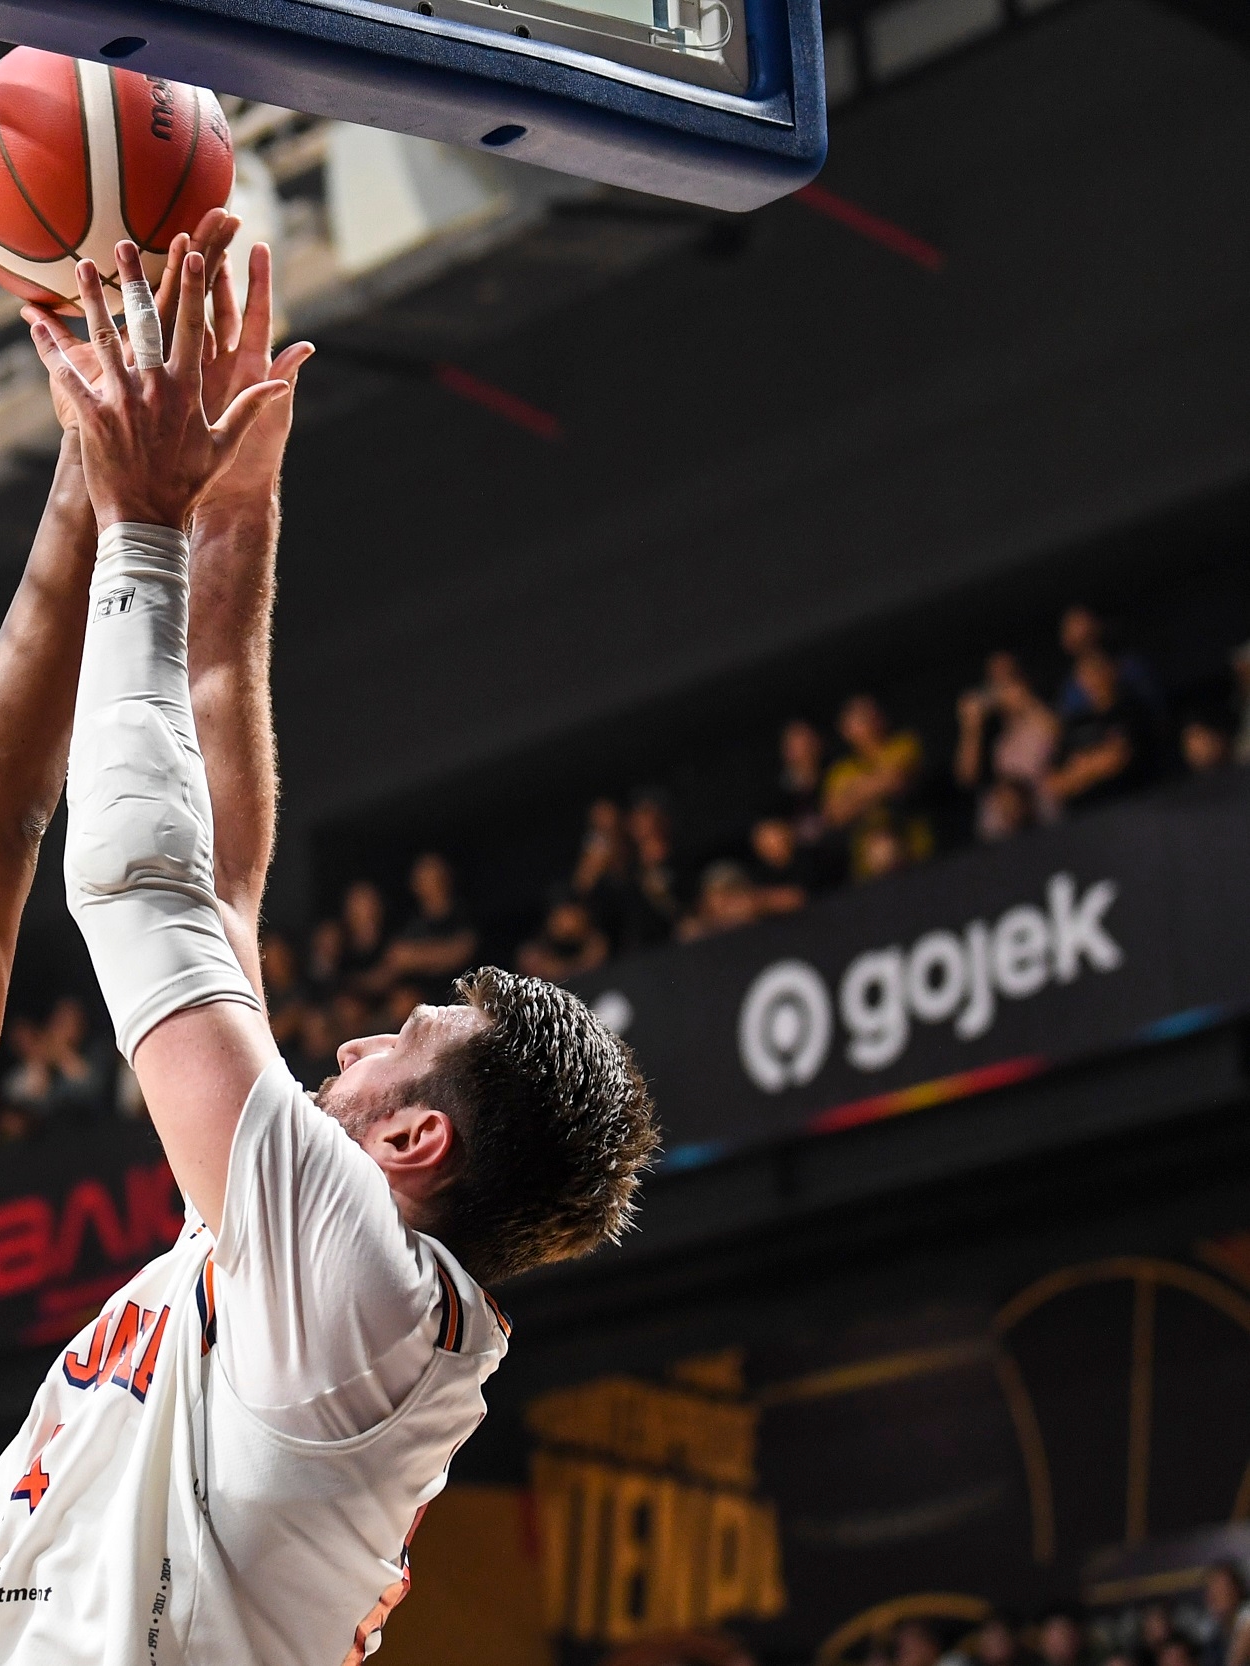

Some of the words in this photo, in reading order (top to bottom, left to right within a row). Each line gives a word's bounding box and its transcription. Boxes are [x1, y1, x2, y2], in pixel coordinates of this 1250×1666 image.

[840, 873, 1120, 1071] gojek
[160, 1557, 171, 1582] 2024
[152, 1592, 166, 1615] 2017
[148, 1627, 159, 1650] 1991
